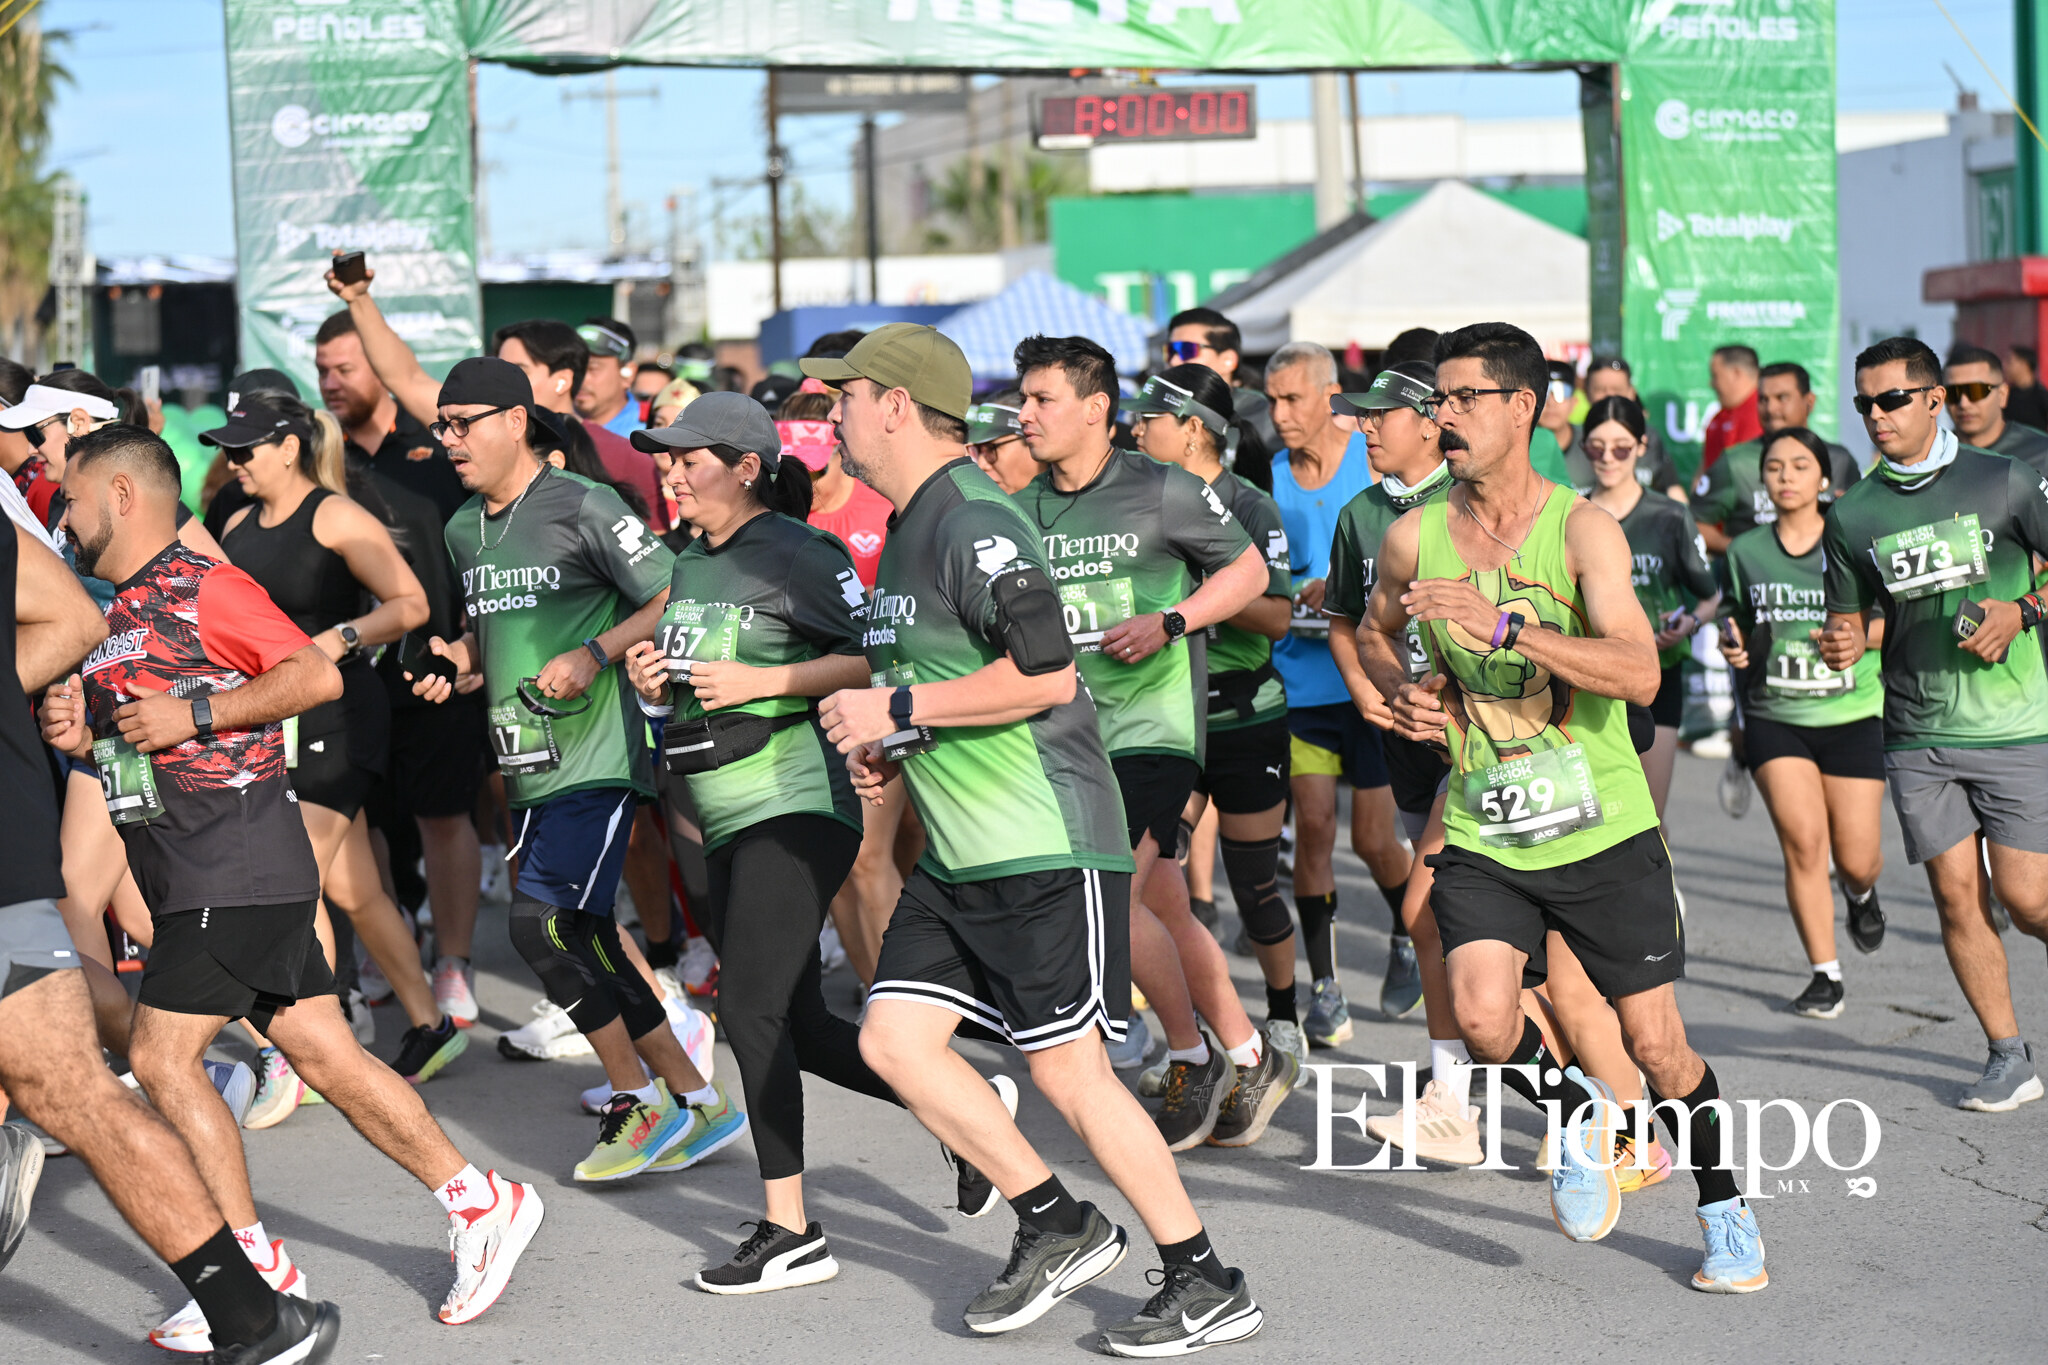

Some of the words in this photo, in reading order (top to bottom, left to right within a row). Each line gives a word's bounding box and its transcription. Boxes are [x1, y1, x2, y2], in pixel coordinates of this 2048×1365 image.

[1692, 109, 1797, 129] cimaco
[1686, 212, 1793, 243] Totalplay
[1043, 533, 1139, 559] Tiempo
[1891, 540, 1953, 580] 573
[1968, 530, 1985, 575] MEDALLA
[475, 563, 561, 592] Tiempo
[478, 594, 538, 615] todos
[873, 588, 916, 625] Tiempo
[1749, 583, 1767, 607] El
[663, 625, 707, 658] 157
[869, 624, 896, 647] todos
[496, 725, 521, 754] 17
[1566, 748, 1582, 759] 529
[135, 753, 157, 808] MEDALLA
[1486, 759, 1531, 774] CARRERA
[1481, 777, 1555, 822] 529
[1573, 761, 1597, 818] MEDALLA
[627, 1110, 662, 1150] HOKA
